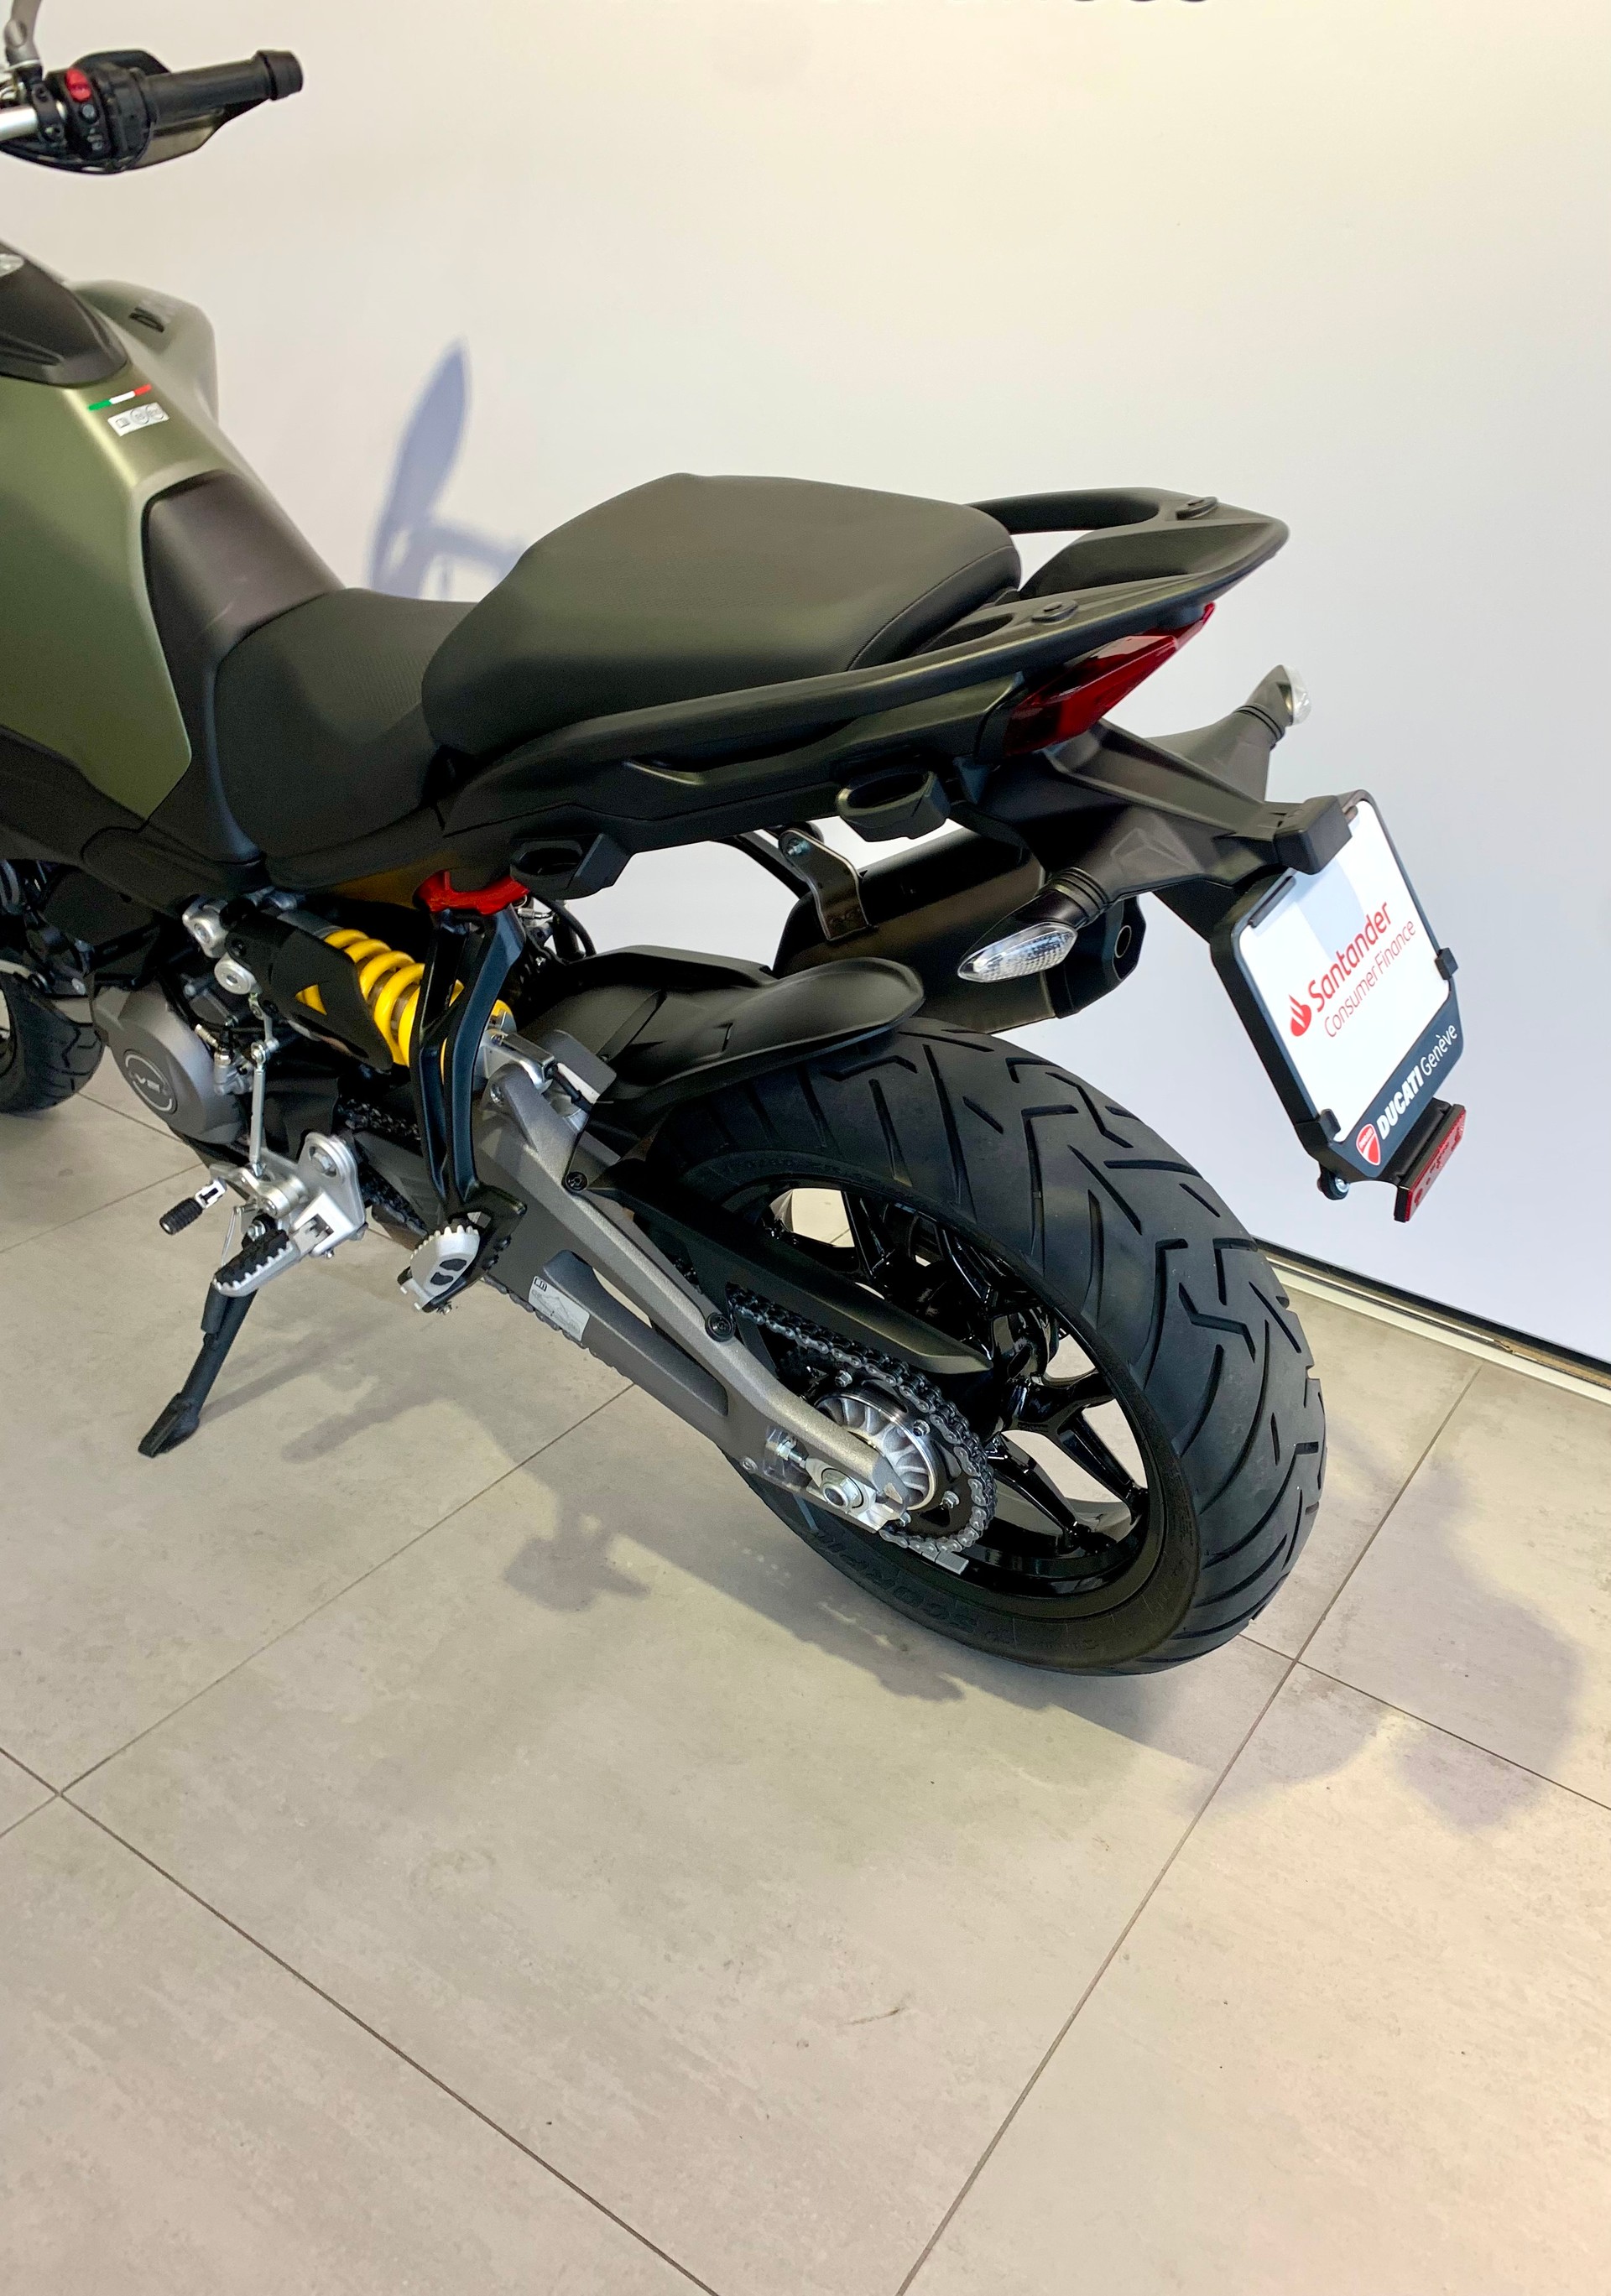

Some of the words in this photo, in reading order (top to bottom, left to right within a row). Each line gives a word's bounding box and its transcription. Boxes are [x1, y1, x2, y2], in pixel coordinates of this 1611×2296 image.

[1307, 901, 1391, 1013] Santander
[1324, 966, 1379, 1038] Consumer
[1374, 920, 1416, 975] Finance
[1376, 1065, 1425, 1140] DUCATI
[1420, 1024, 1458, 1076] Genève
